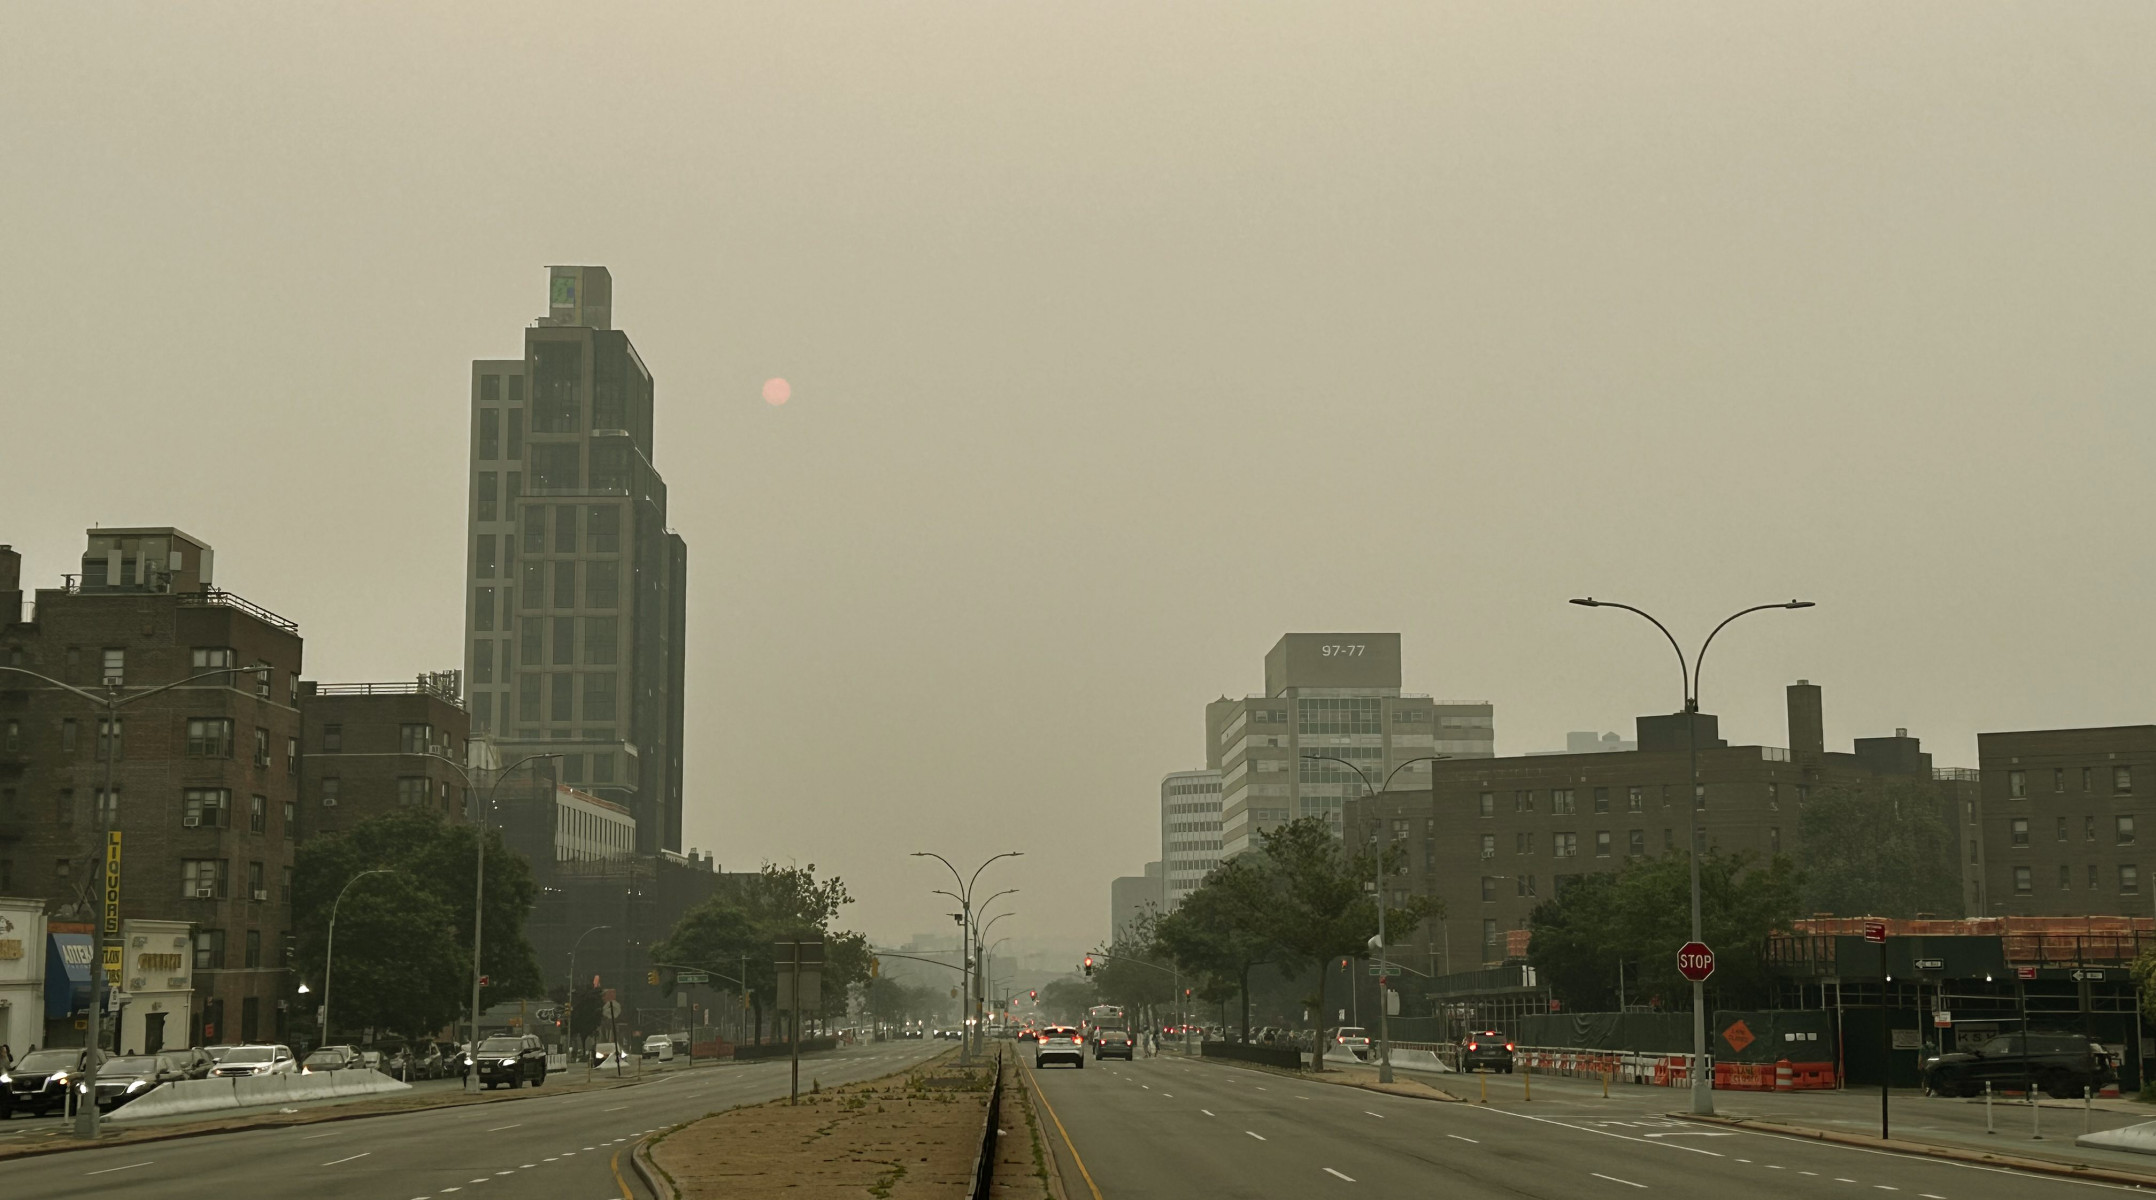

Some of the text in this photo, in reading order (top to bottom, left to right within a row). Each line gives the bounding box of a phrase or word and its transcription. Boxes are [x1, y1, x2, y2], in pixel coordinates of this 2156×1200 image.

[1322, 645, 1365, 657] 97-77
[107, 833, 120, 931] LIQUORS
[1680, 954, 1712, 969] STOP
